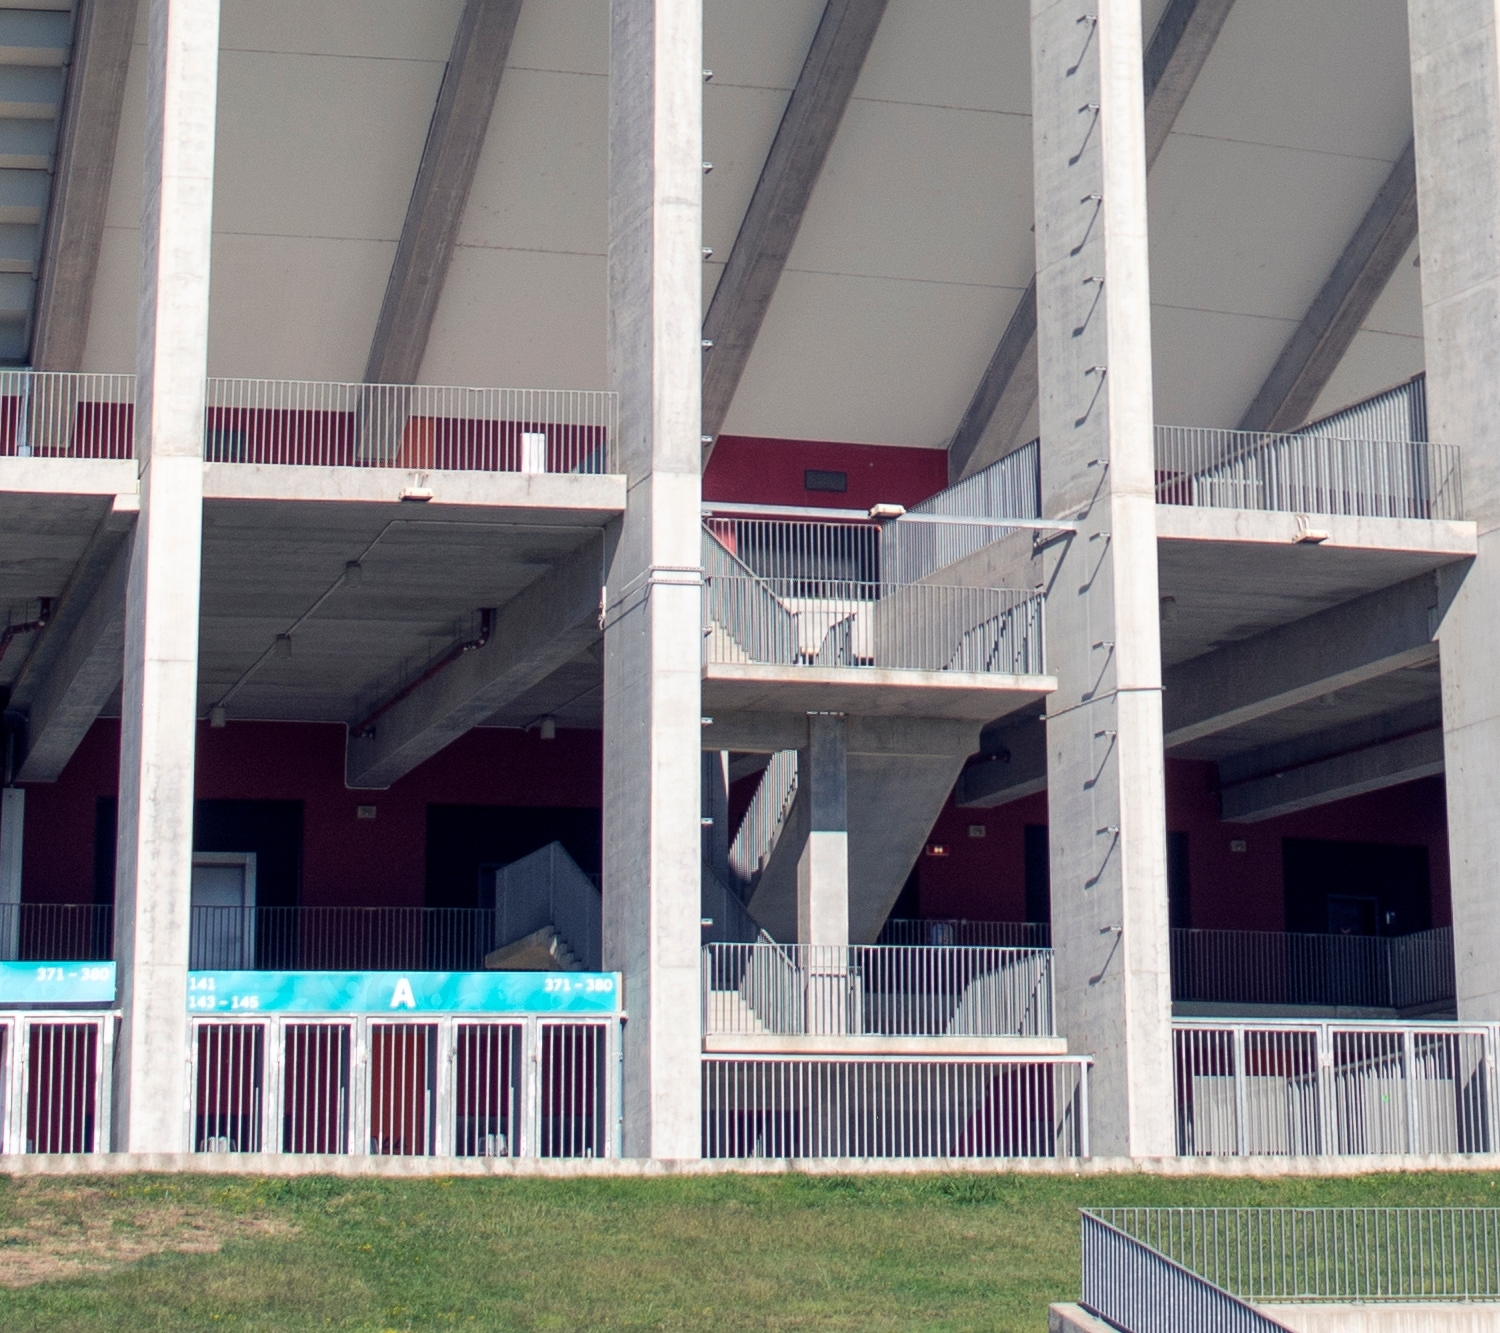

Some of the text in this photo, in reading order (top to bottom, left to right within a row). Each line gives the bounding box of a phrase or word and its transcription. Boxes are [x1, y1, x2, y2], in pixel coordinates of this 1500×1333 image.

[37, 967, 64, 982] 371
[81, 967, 110, 982] 380
[189, 977, 215, 991] 141
[545, 978, 570, 992] 371
[585, 978, 613, 992] 380
[390, 977, 417, 1008] A
[189, 994, 216, 1009] 143
[231, 994, 259, 1009] 145
